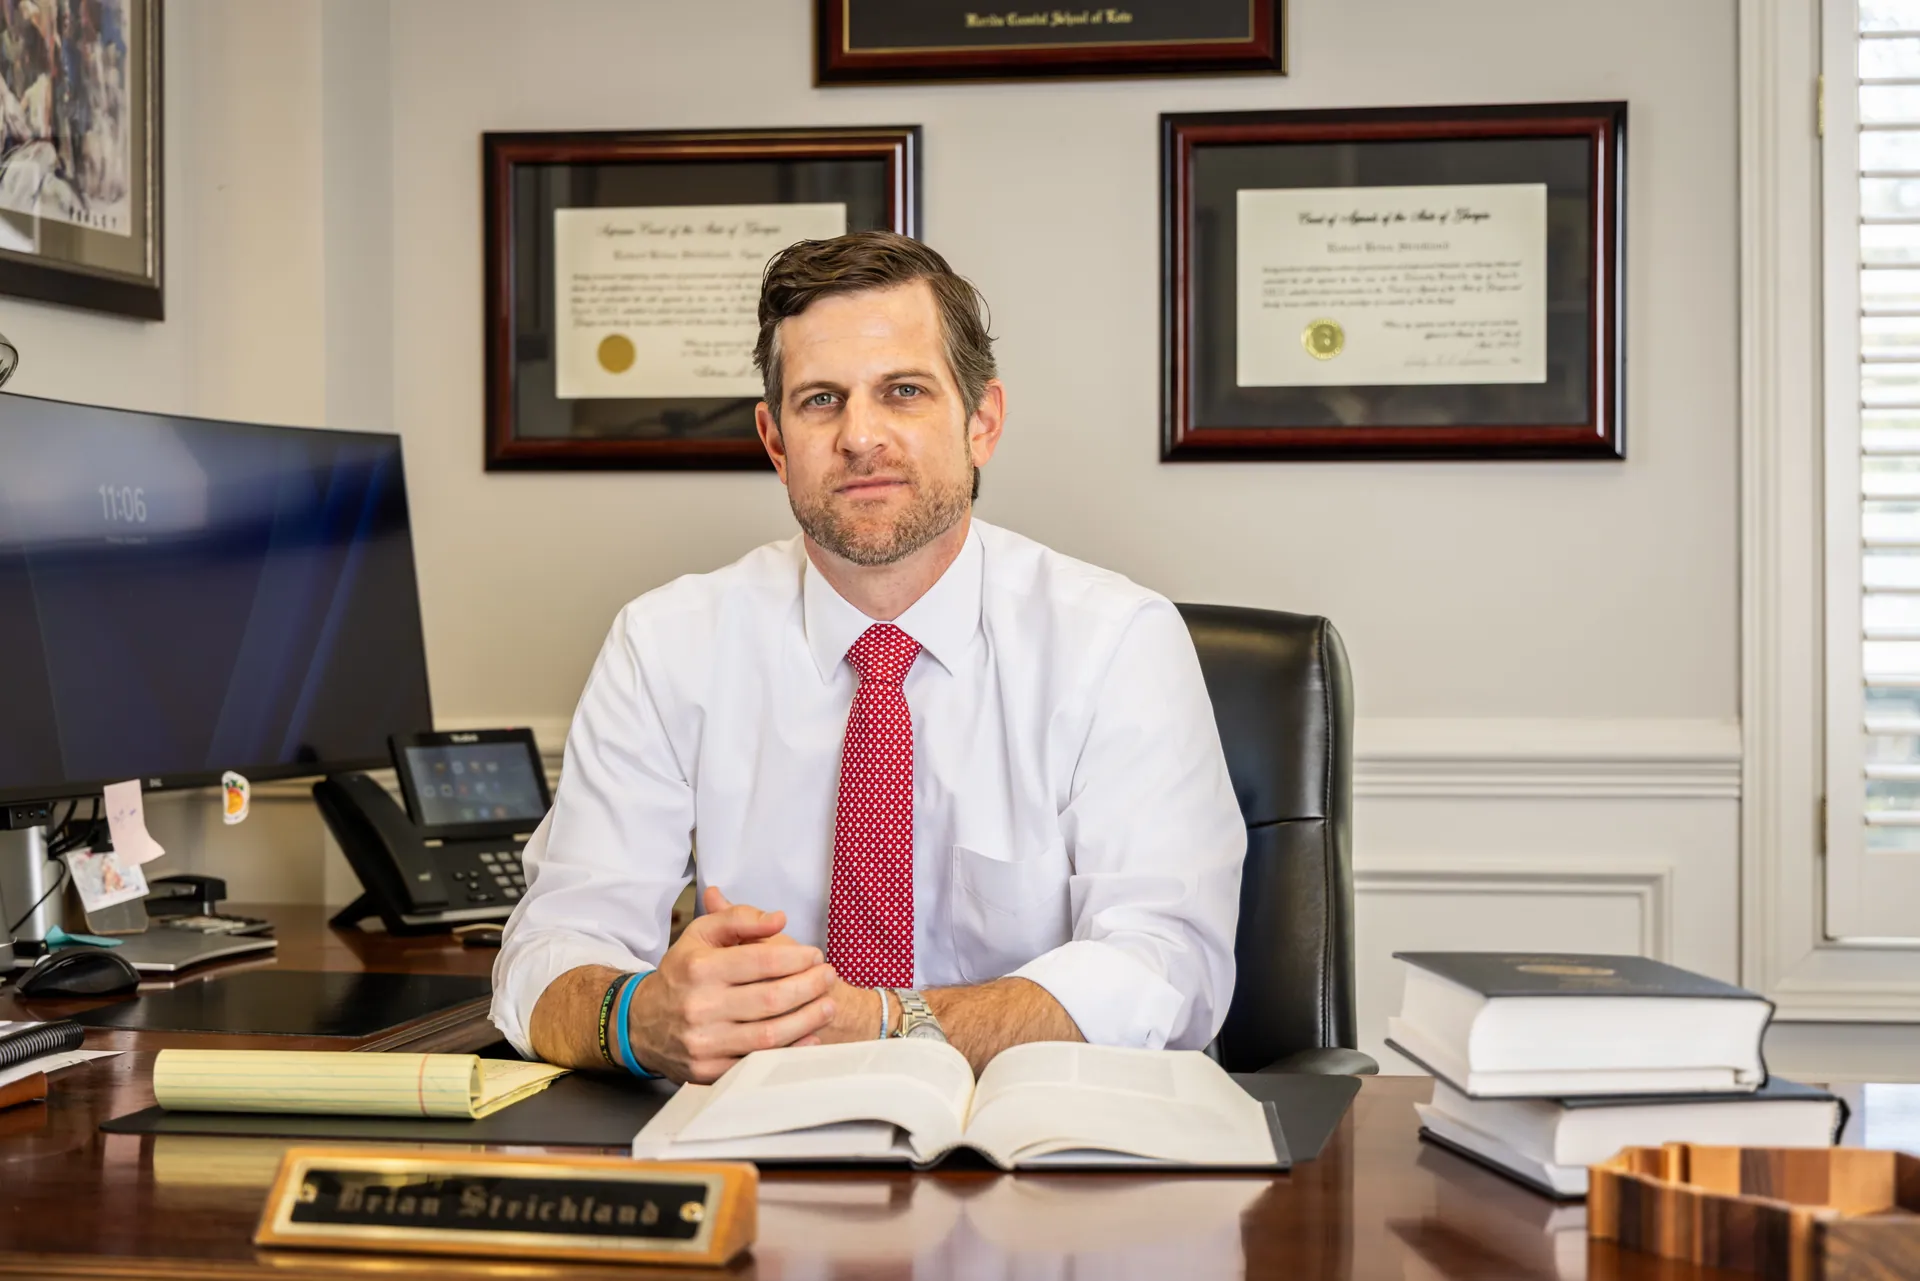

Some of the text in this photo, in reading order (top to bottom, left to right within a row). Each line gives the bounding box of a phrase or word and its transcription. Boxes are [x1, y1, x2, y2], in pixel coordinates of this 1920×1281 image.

[1051, 10, 1088, 27] School
[1090, 10, 1102, 23] of
[99, 483, 146, 522] 11:06
[599, 987, 614, 1046] CELEBRATE
